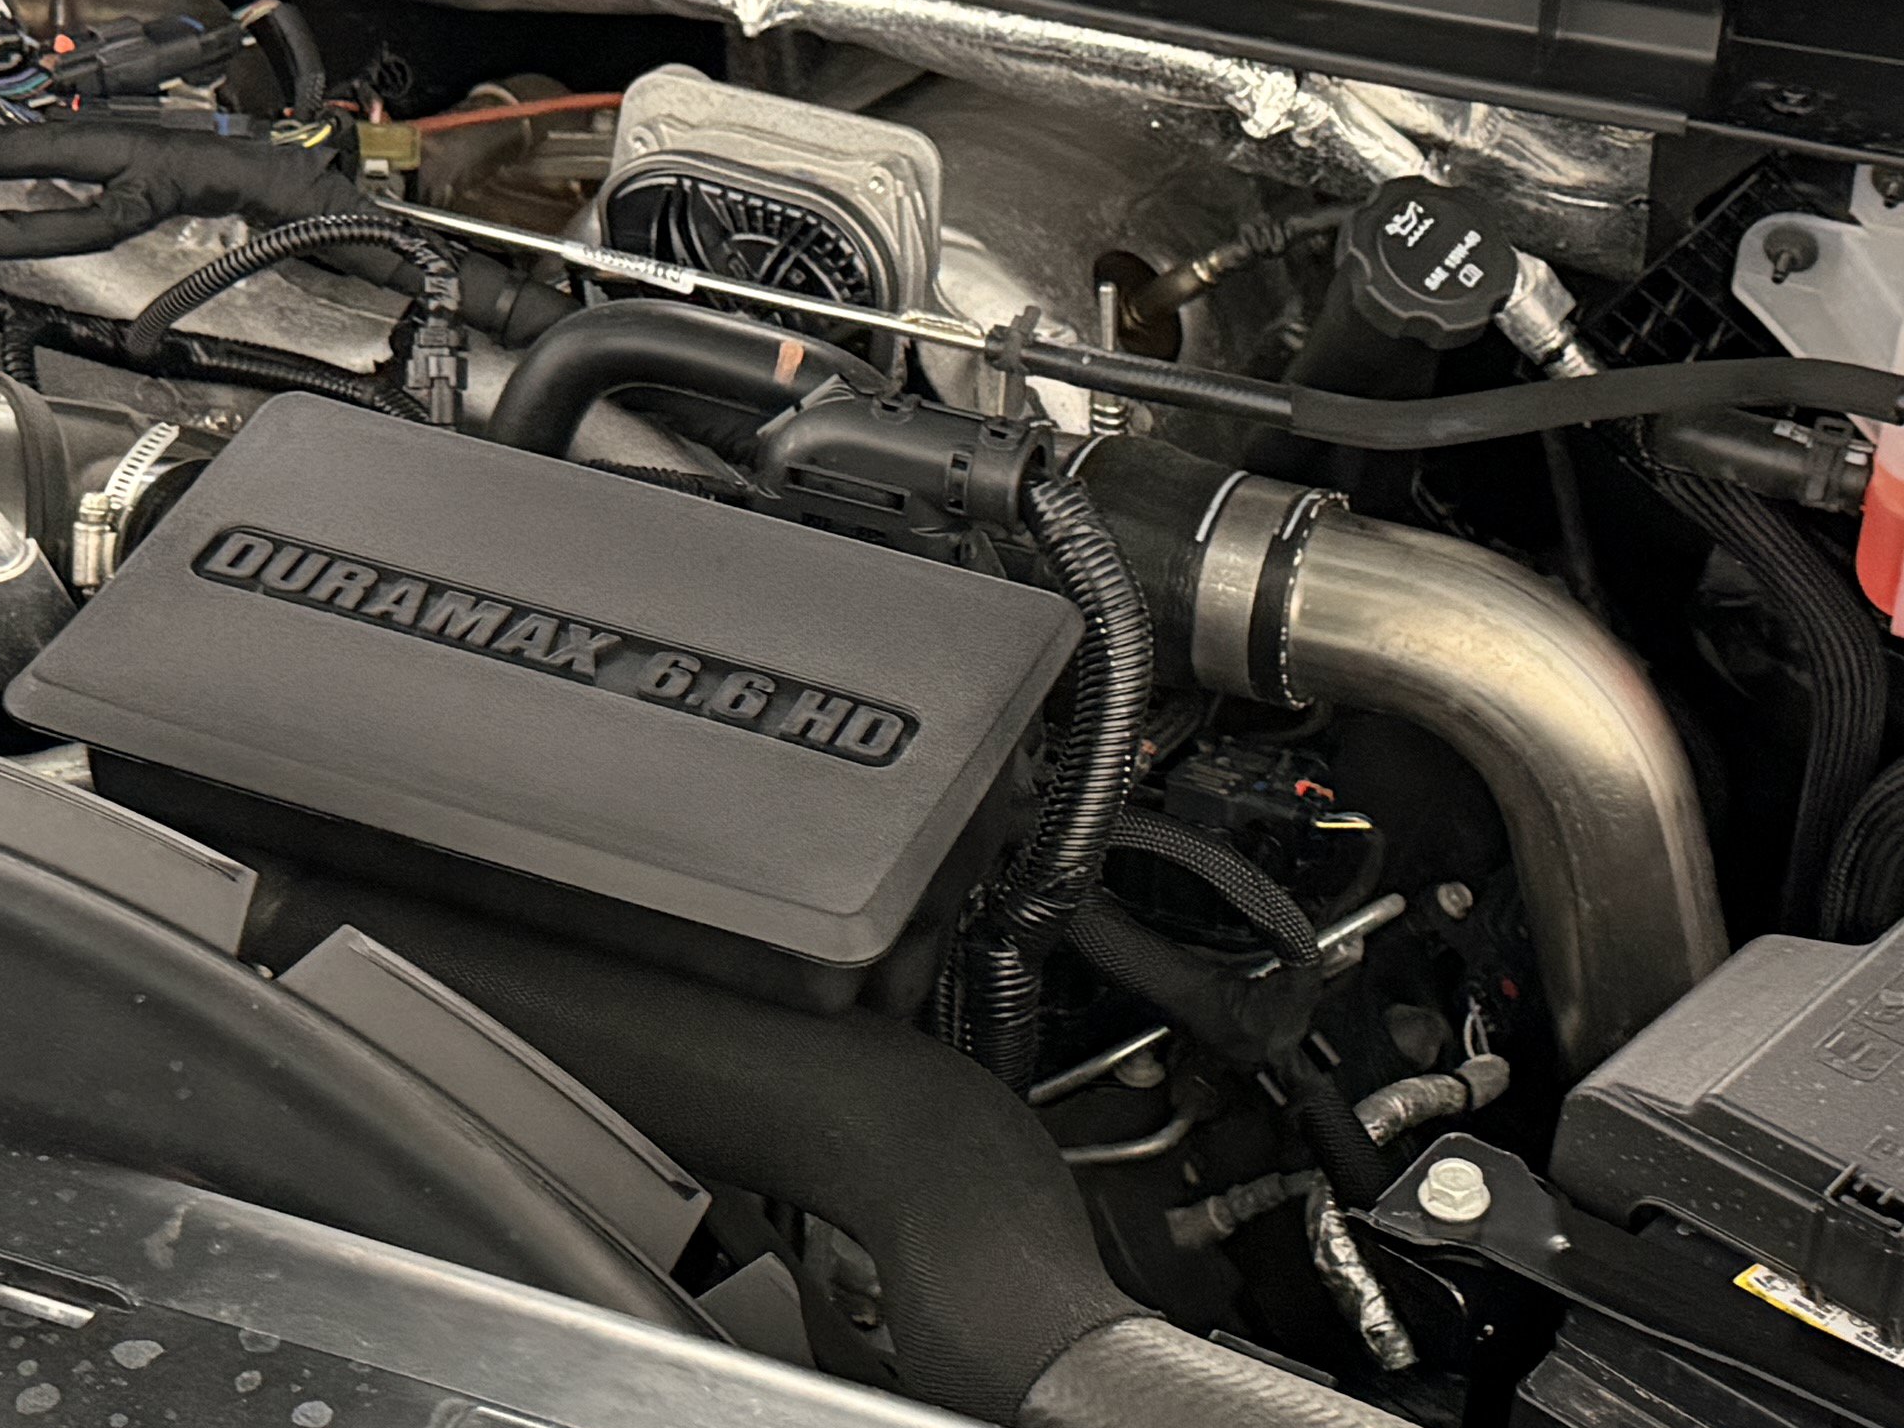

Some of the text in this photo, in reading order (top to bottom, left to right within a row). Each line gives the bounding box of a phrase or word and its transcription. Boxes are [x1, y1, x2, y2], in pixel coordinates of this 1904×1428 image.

[204, 530, 905, 758] DURAMAX 6.6 HD
